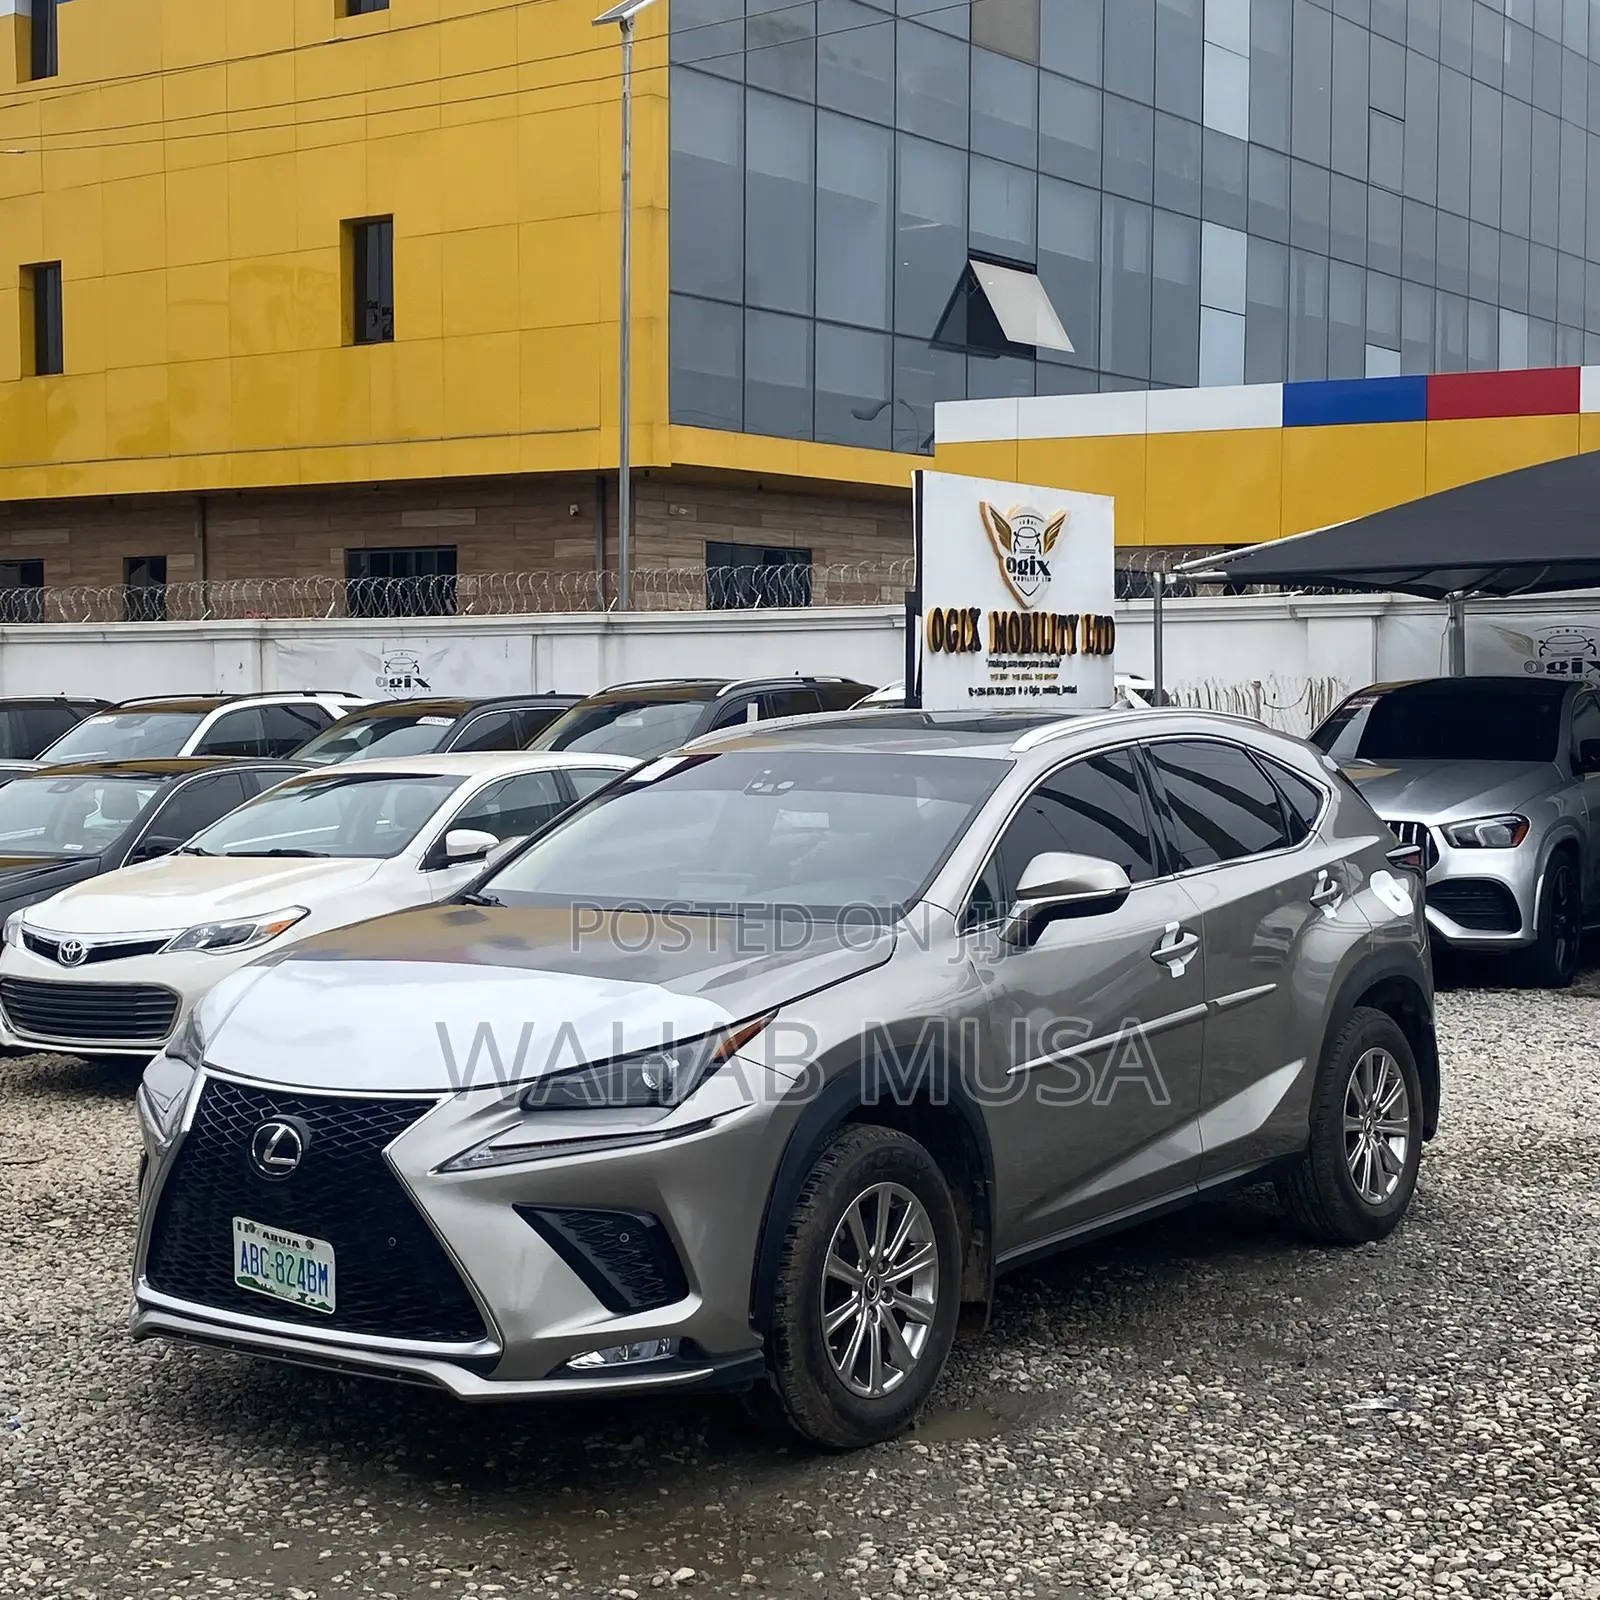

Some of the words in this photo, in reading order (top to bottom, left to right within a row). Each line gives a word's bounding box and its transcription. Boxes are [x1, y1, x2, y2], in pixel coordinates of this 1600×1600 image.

[927, 607, 982, 653] OGIX
[988, 610, 1079, 656] MOBILITY
[1080, 613, 1115, 656] LTD
[262, 1231, 300, 1249] ABUJA
